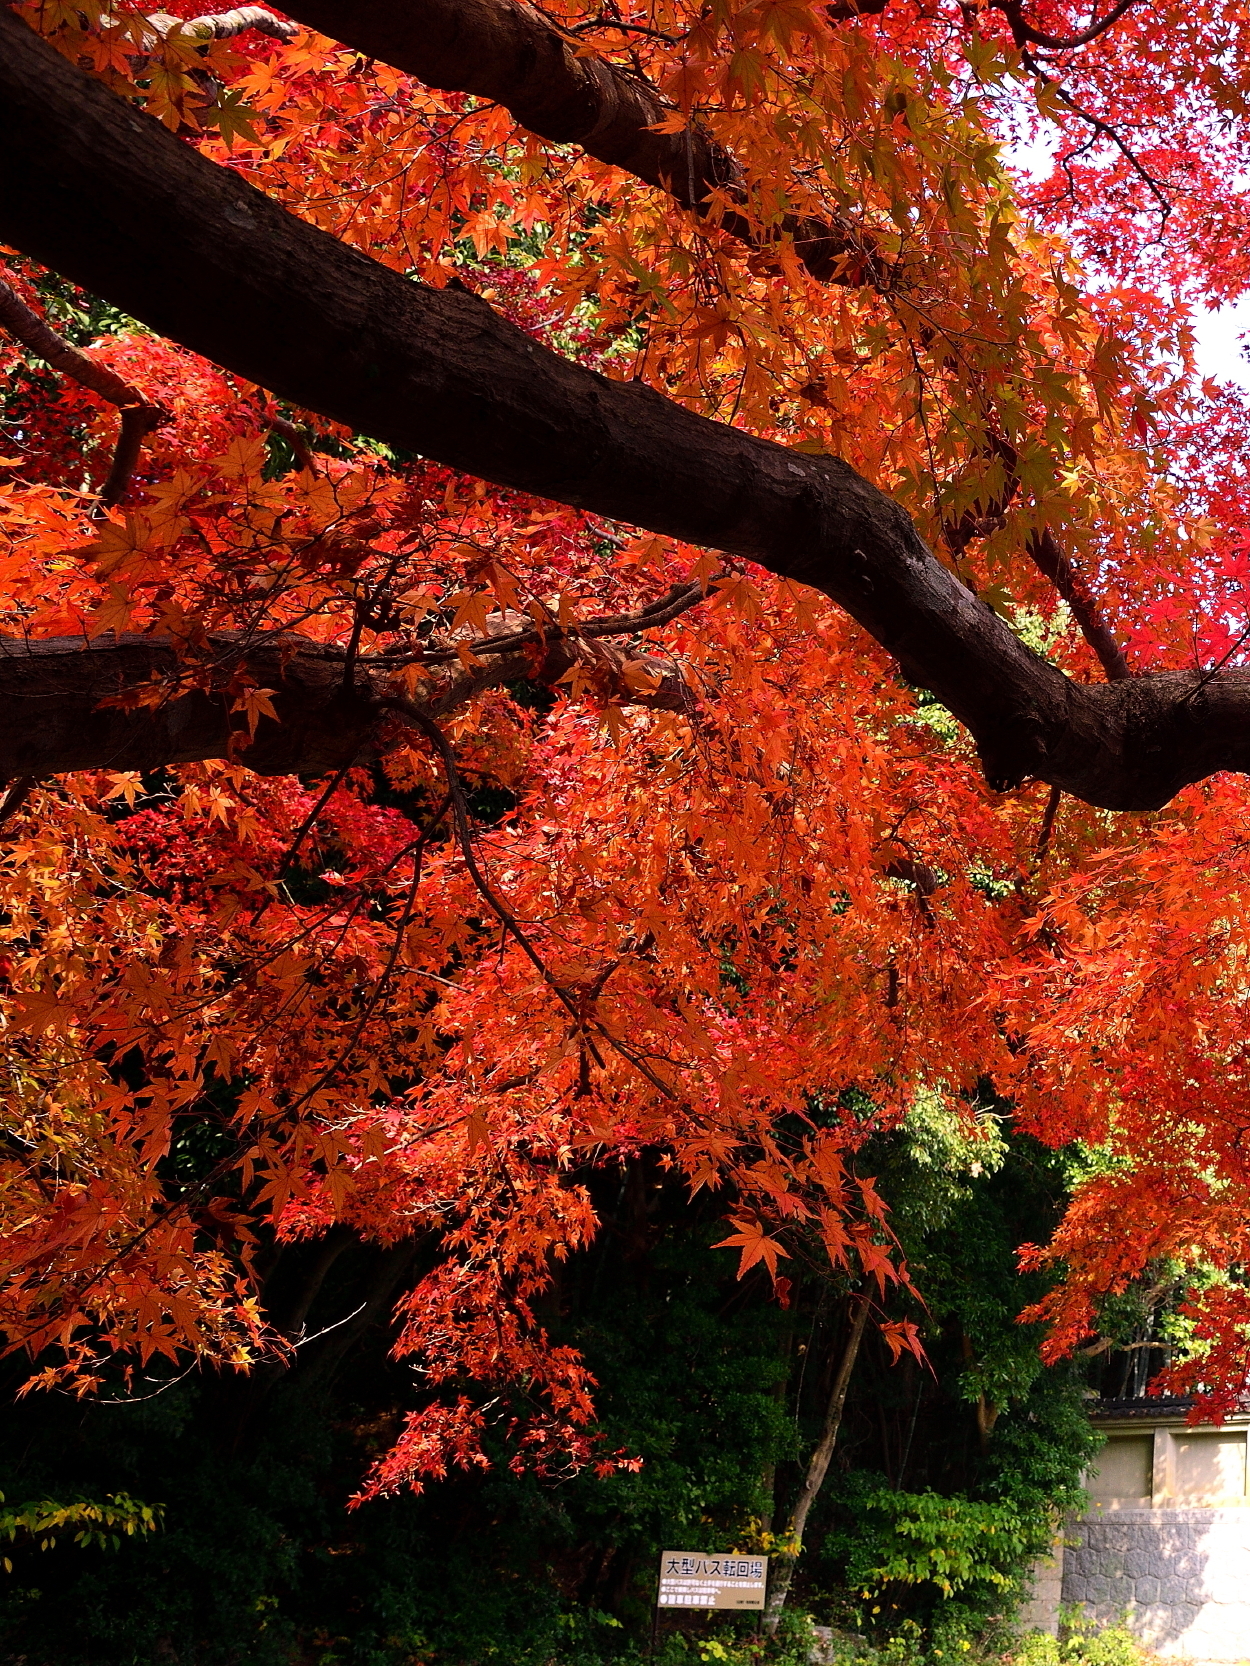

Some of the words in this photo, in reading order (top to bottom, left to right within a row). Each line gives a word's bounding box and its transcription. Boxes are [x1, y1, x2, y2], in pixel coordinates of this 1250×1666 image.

[666, 1558, 762, 1578] 大型バス転回場
